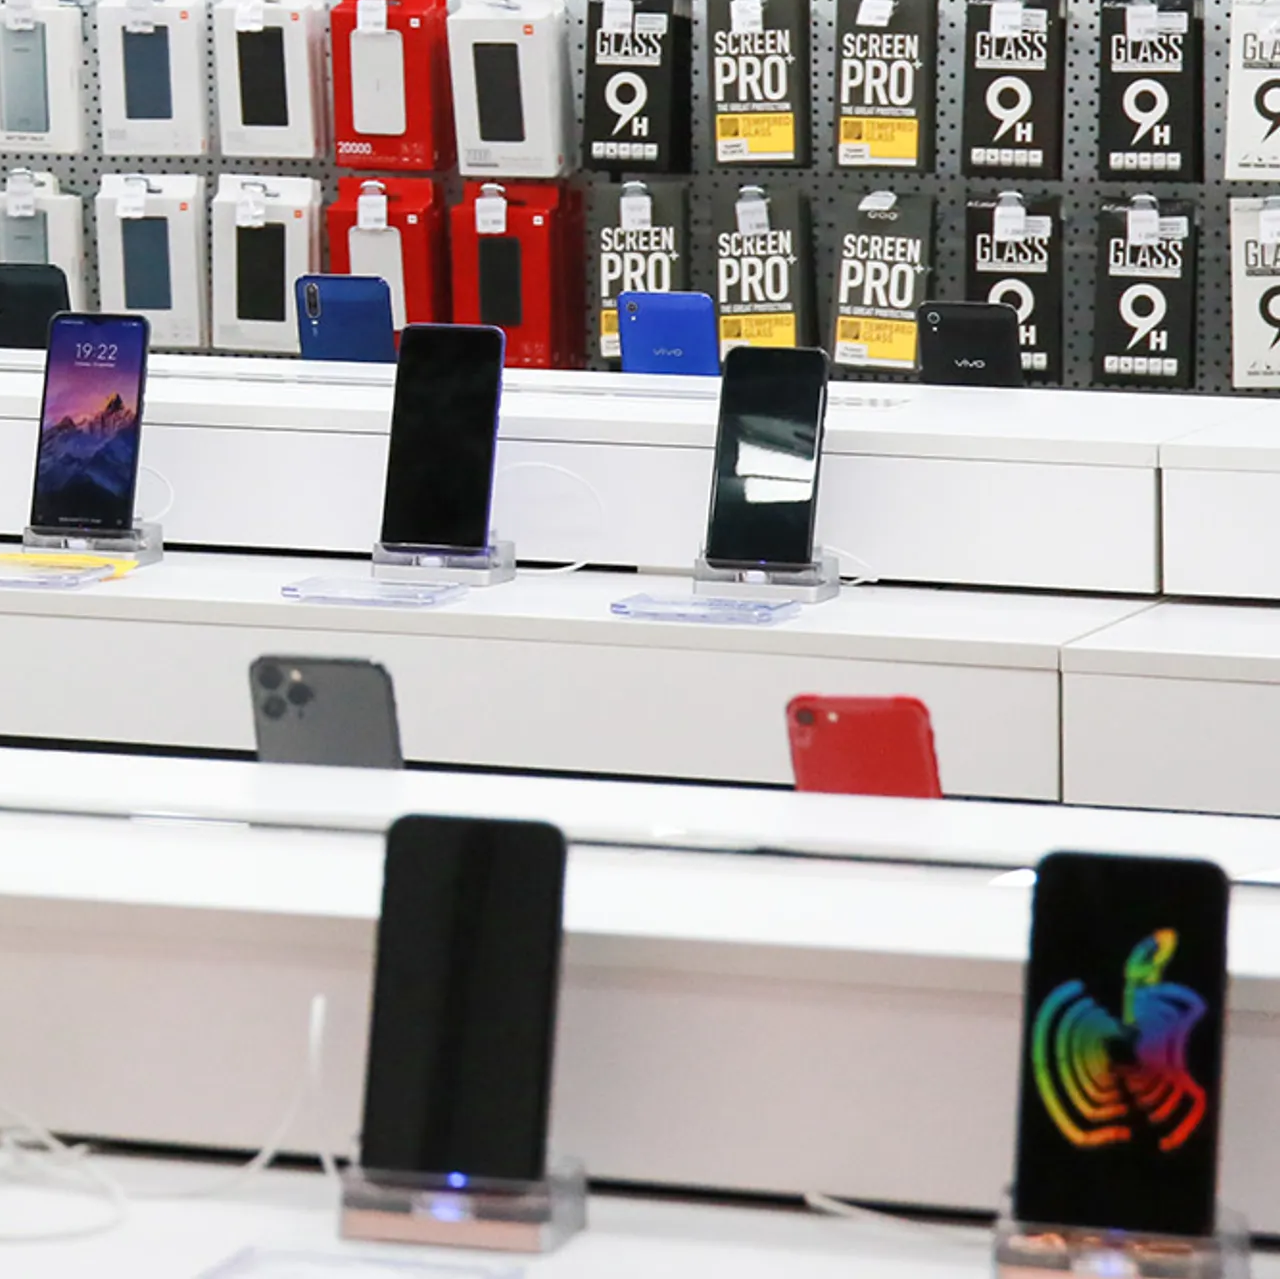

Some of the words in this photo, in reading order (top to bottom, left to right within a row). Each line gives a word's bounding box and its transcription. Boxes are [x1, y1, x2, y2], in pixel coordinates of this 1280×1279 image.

[596, 29, 662, 56] GLASS
[714, 29, 790, 55] SCREEN
[842, 33, 919, 59] SCREEN
[976, 31, 1048, 60] GLASS
[1111, 34, 1183, 64] GLASS
[338, 141, 372, 155] 20000
[600, 226, 675, 251] SCREEN
[718, 229, 791, 257] SCREEN
[842, 233, 921, 262] SCREEN
[976, 232, 1048, 263] GLASS
[1109, 237, 1183, 269] GLASS
[75, 342, 119, 360] 19:22
[653, 347, 683, 357] vivo
[954, 359, 986, 369] vivo
